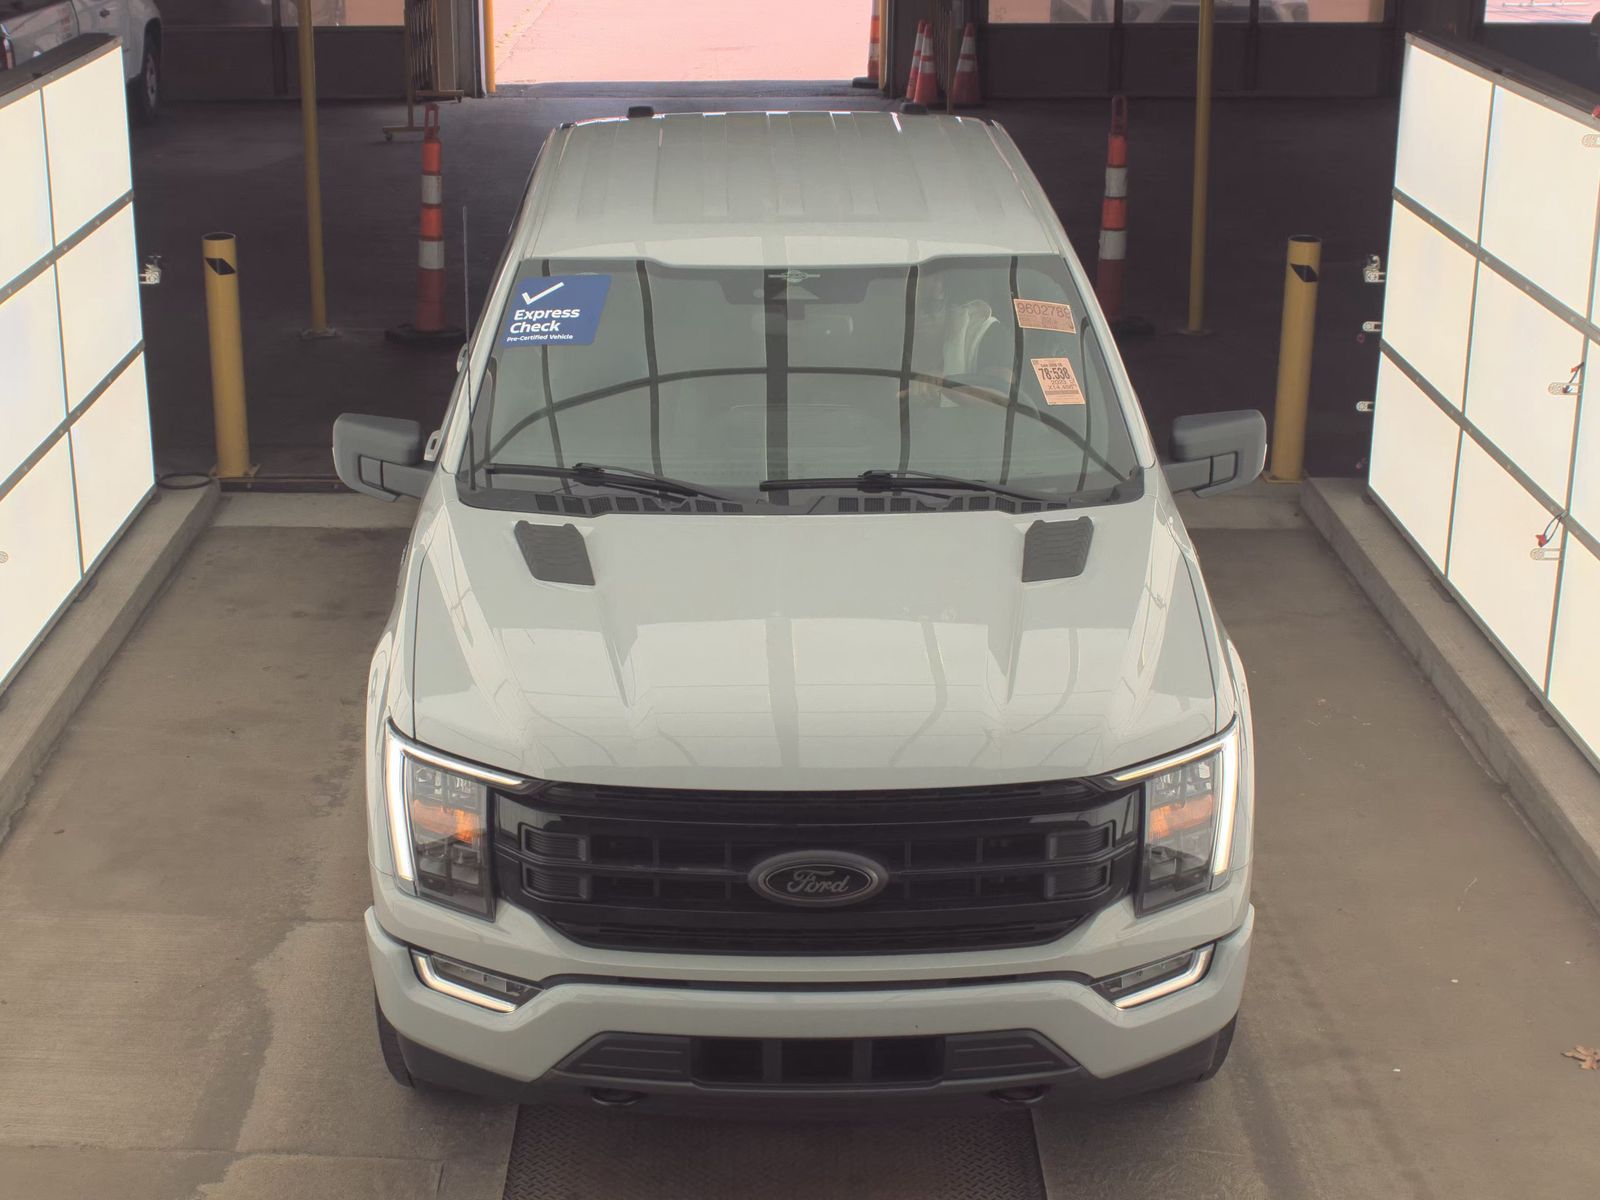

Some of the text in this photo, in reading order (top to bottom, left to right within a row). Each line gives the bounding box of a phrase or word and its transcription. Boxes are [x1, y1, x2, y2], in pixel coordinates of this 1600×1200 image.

[514, 309, 580, 321] Express
[510, 320, 560, 333] Check
[1038, 366, 1071, 380] 78:538
[787, 869, 851, 893] Ford
